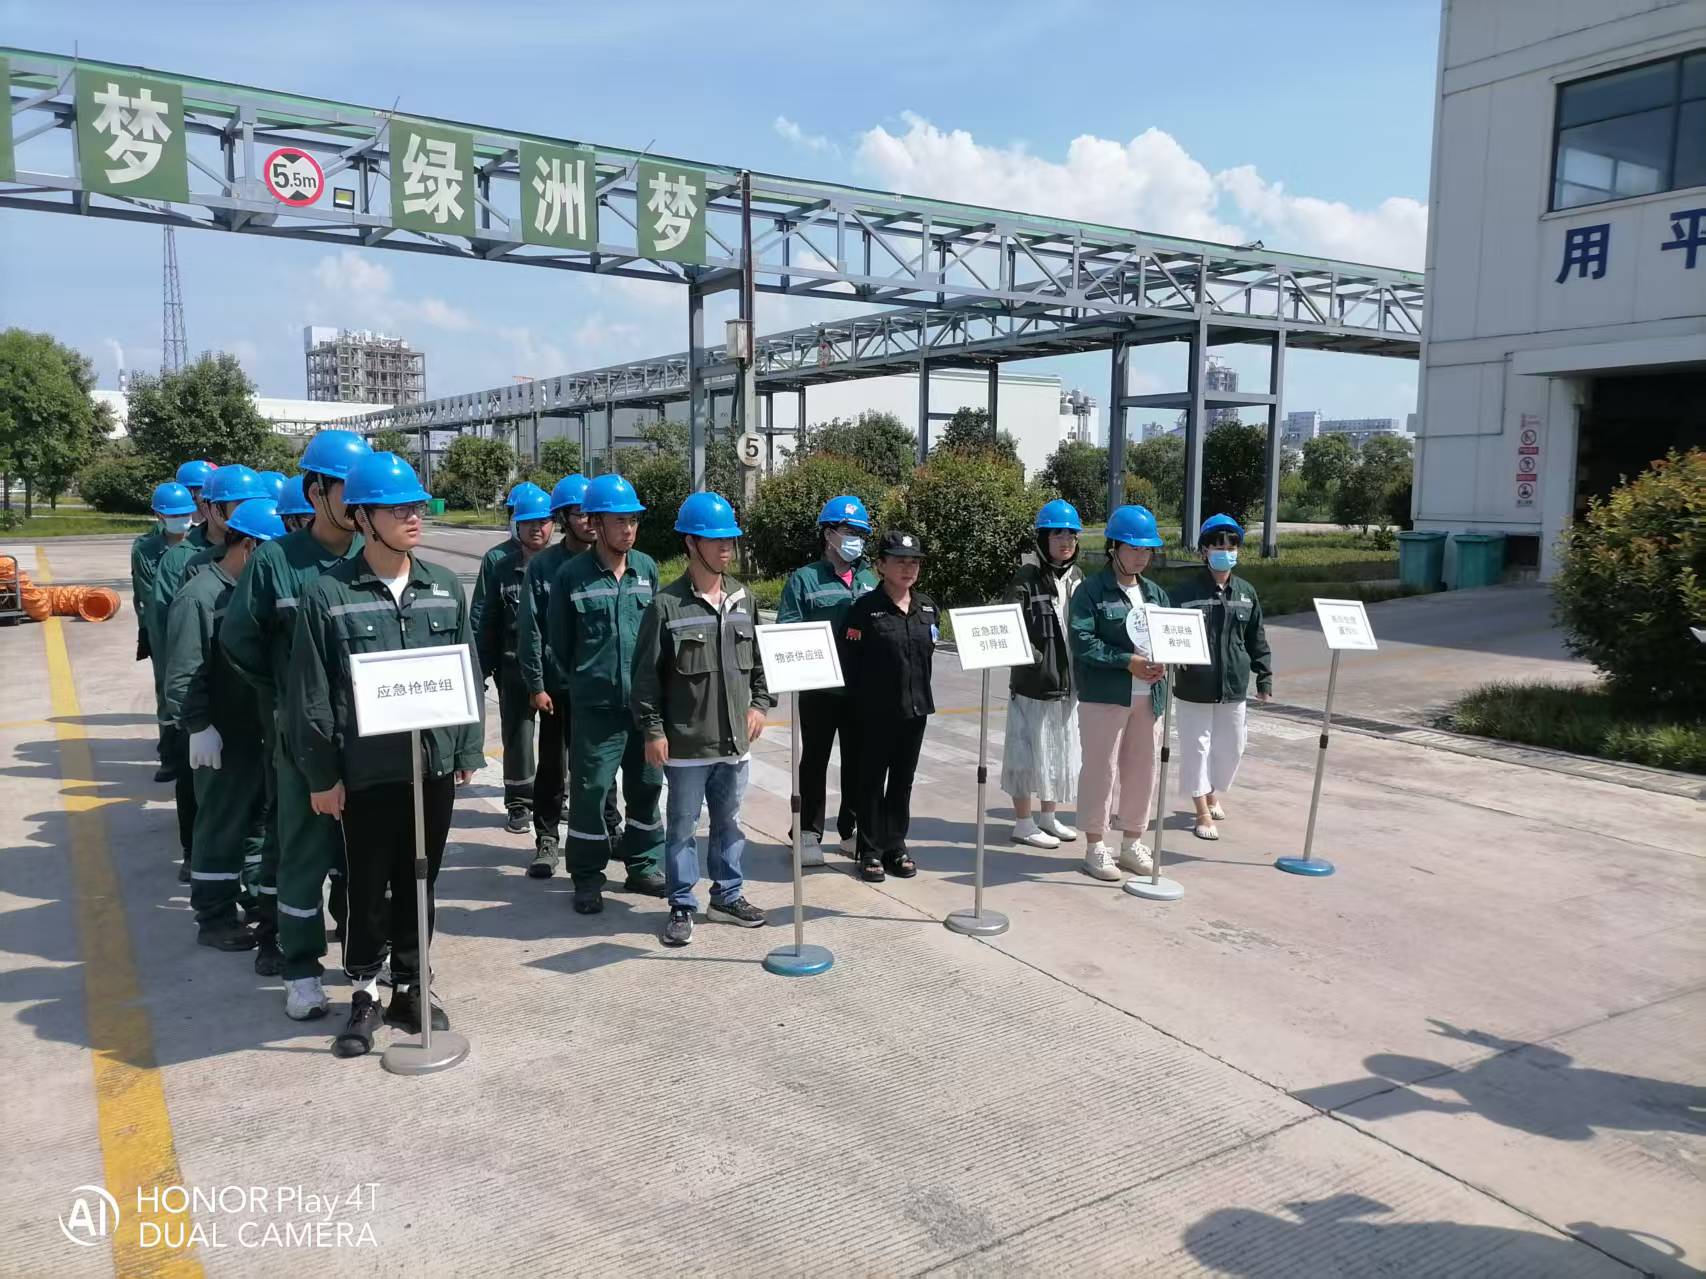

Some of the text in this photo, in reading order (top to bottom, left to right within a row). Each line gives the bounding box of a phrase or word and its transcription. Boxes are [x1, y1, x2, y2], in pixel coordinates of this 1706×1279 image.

[272, 163, 317, 189] 5.5m
[745, 437, 759, 458] 5
[971, 624, 1009, 637] 应急疏散
[1161, 624, 1193, 636] 通讯联络
[979, 639, 1009, 651] 引导组
[1168, 638, 1192, 648] 救护组
[774, 648, 825, 664] 物资供应组
[377, 678, 454, 699] 应急抢险组
